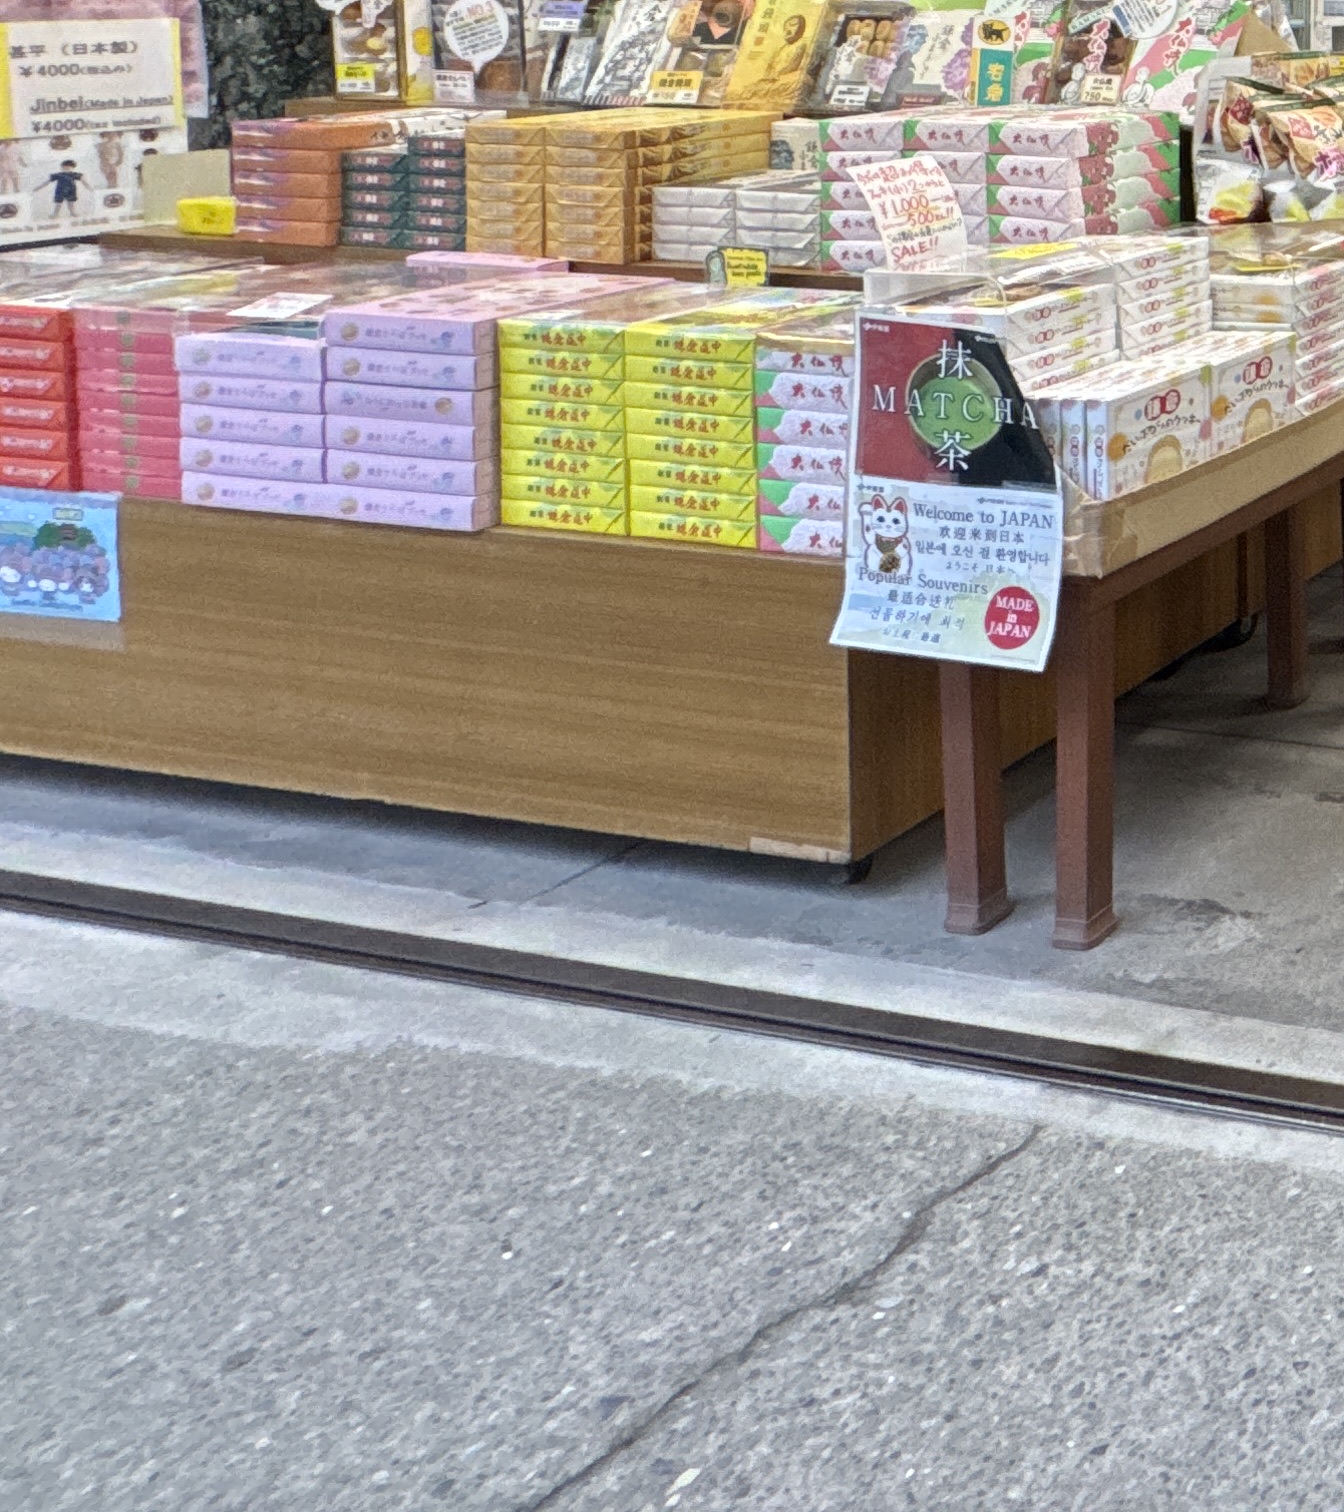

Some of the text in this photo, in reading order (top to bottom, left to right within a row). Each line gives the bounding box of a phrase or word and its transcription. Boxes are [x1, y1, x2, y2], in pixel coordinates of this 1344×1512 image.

[891, 236, 939, 263] SALE!!
[937, 339, 974, 379] 抹
[872, 384, 1040, 430] MATCHA
[934, 429, 972, 471] 茶
[913, 503, 1054, 529] Welcome to JAPAN
[939, 527, 1025, 544] 欢迎来到日本
[915, 540, 947, 555] 일본에
[951, 546, 974, 559] 오신
[995, 547, 1050, 564] 환영합니다
[858, 567, 989, 595] Popular Souvenirs
[995, 595, 1035, 612] MADE
[986, 621, 1032, 639] JAPAN
[1006, 610, 1018, 624] in
